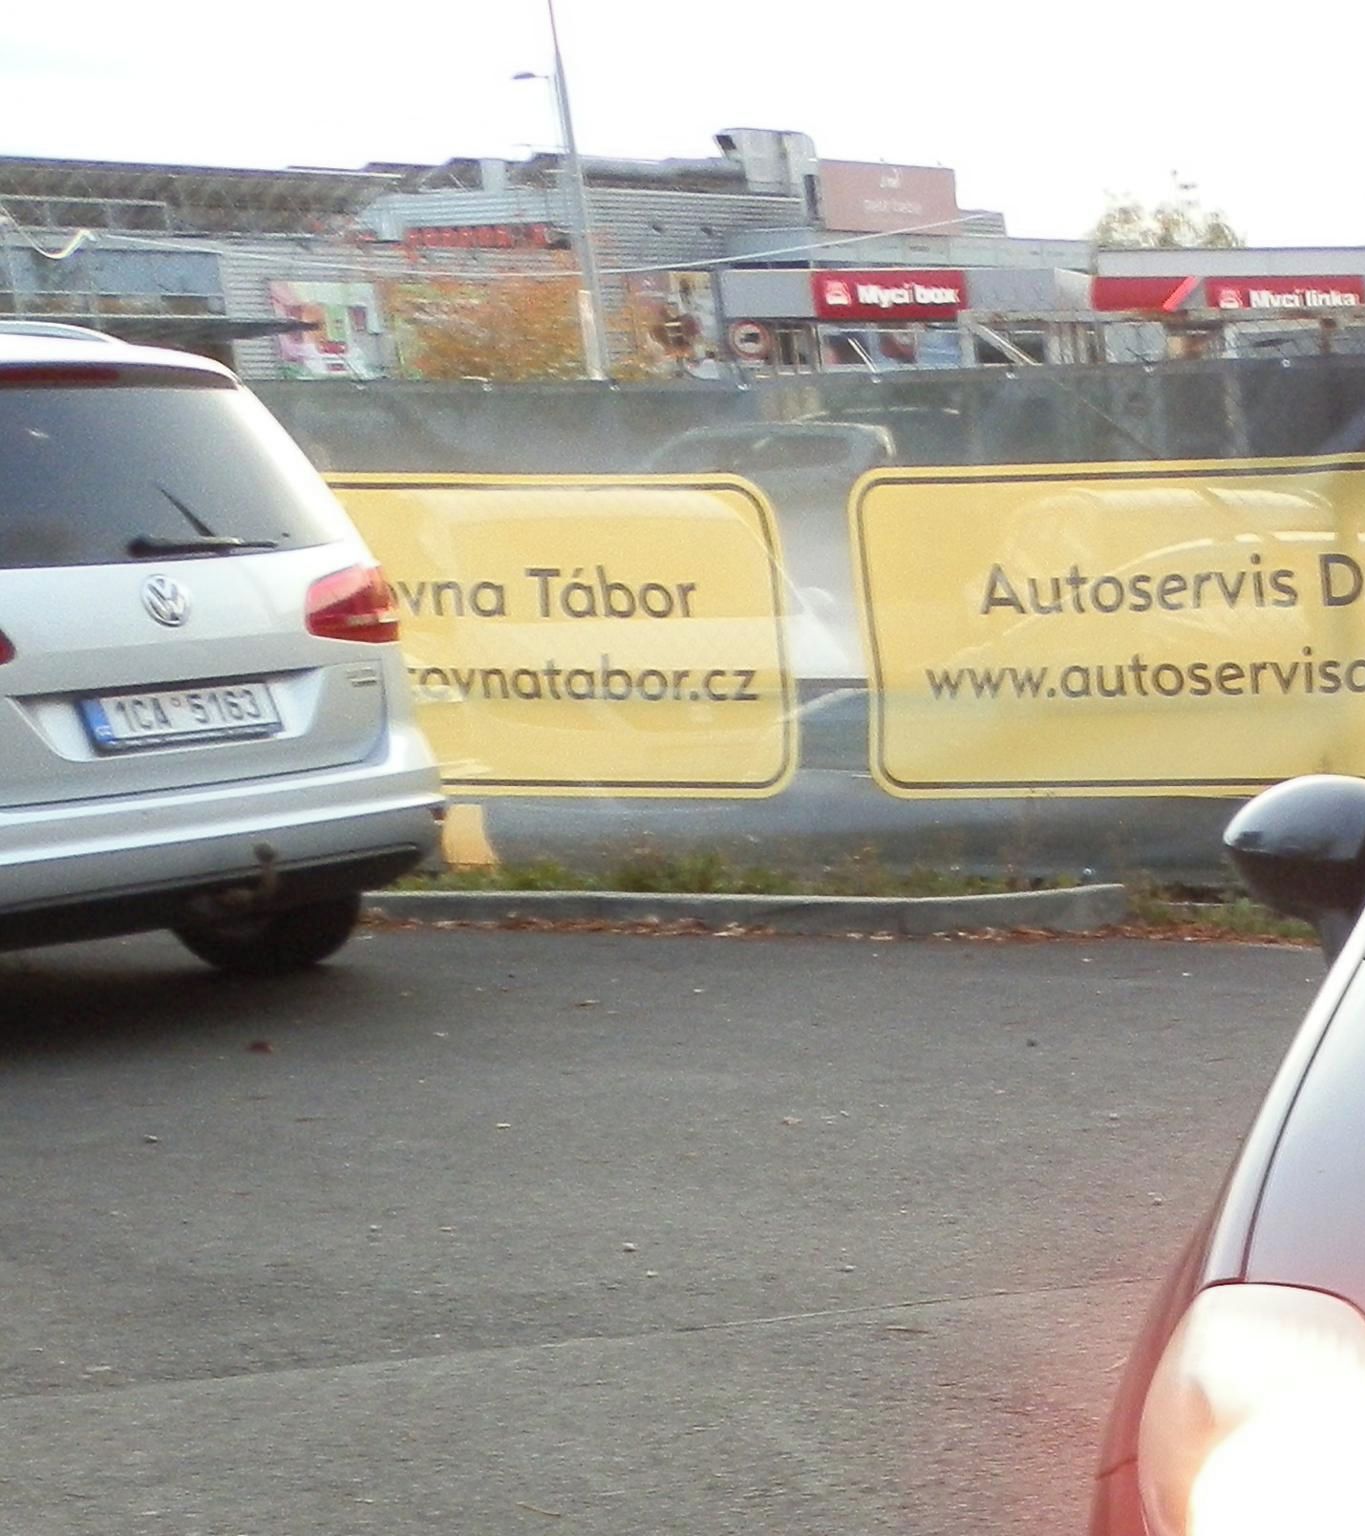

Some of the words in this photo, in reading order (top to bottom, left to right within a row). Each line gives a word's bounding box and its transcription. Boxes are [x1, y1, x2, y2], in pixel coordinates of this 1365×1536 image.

[913, 282, 960, 304] box
[1305, 289, 1360, 306] linka
[525, 565, 697, 618] Tábor
[980, 553, 1299, 615] Autoservis
[407, 653, 760, 700] ovnatabor.cz
[115, 698, 171, 733] 1CA
[186, 687, 262, 724] 5163
